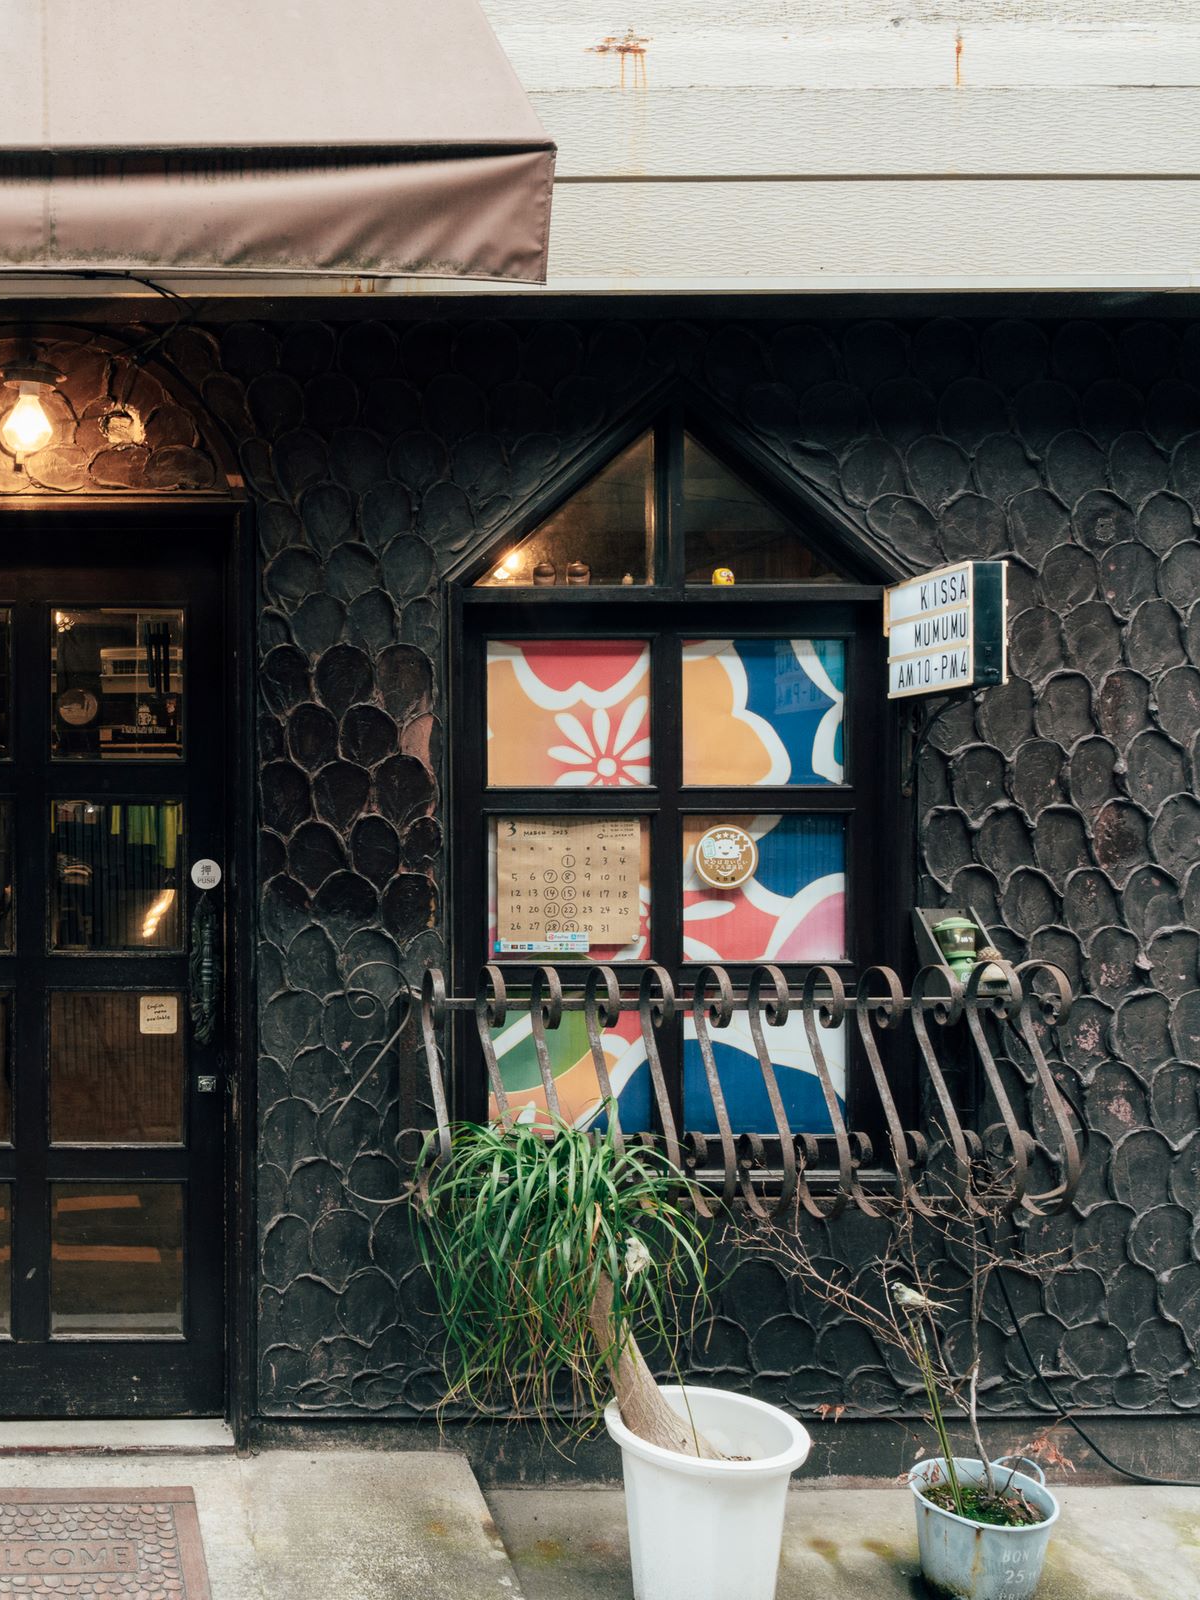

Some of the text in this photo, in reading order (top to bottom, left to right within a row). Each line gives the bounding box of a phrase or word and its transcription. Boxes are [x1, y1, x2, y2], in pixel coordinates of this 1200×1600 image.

[920, 574, 967, 611] KISSA
[914, 612, 967, 648] MUMUMU
[898, 651, 967, 689] AM10-PM4
[507, 822, 516, 837] 3
[585, 857, 591, 866] 2
[201, 865, 211, 875] 押
[529, 922, 539, 930] 27
[565, 923, 574, 931] 29
[601, 924, 609, 932] 31
[1005, 1570, 1025, 1583] 25
